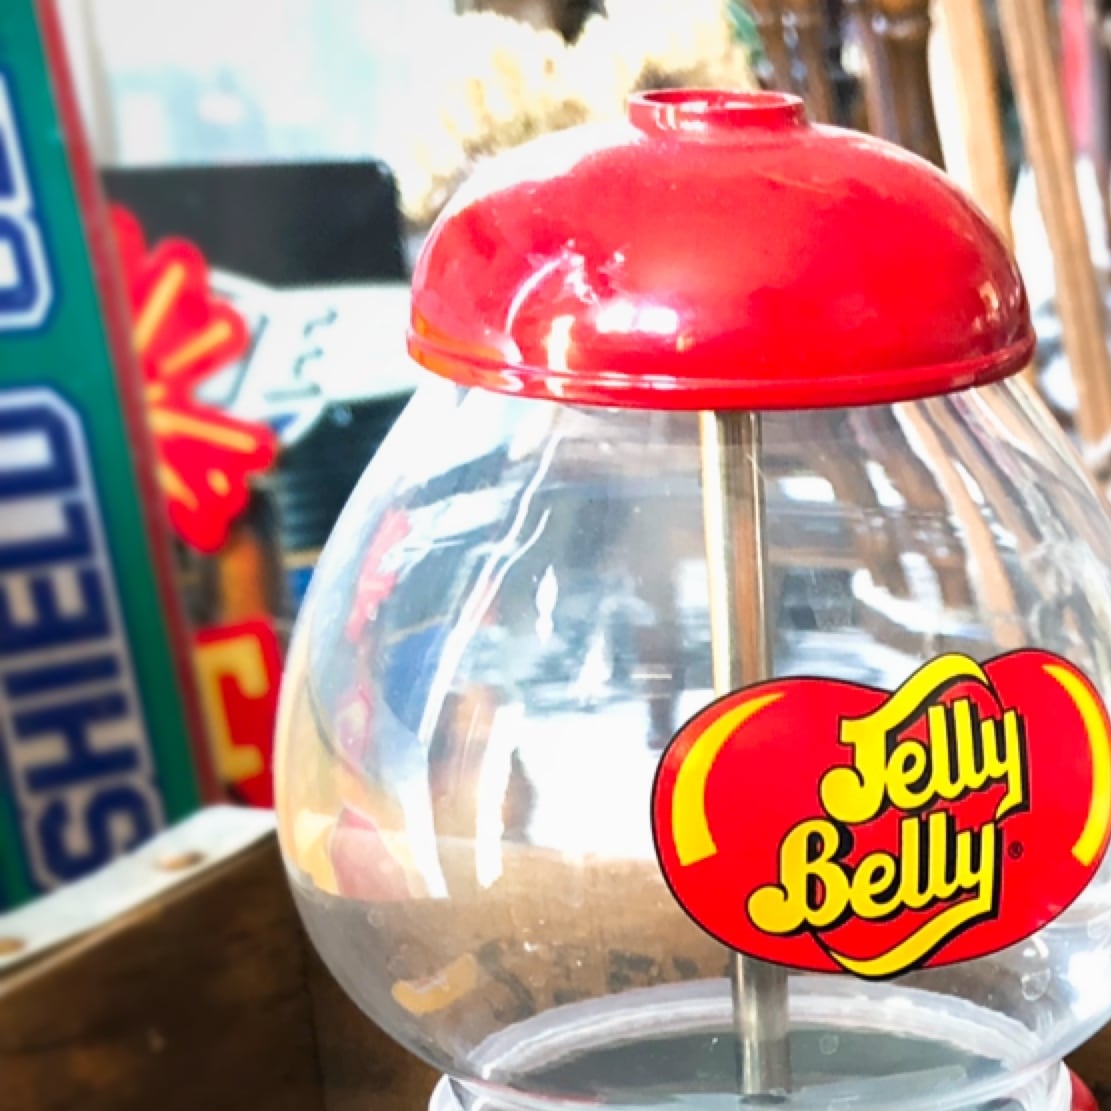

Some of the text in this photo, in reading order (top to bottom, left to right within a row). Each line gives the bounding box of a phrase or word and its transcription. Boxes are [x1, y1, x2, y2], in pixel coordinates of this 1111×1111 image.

[0, 388, 165, 890] SHIELD
[819, 652, 1025, 823] Jelly
[747, 811, 1001, 974] Belly
